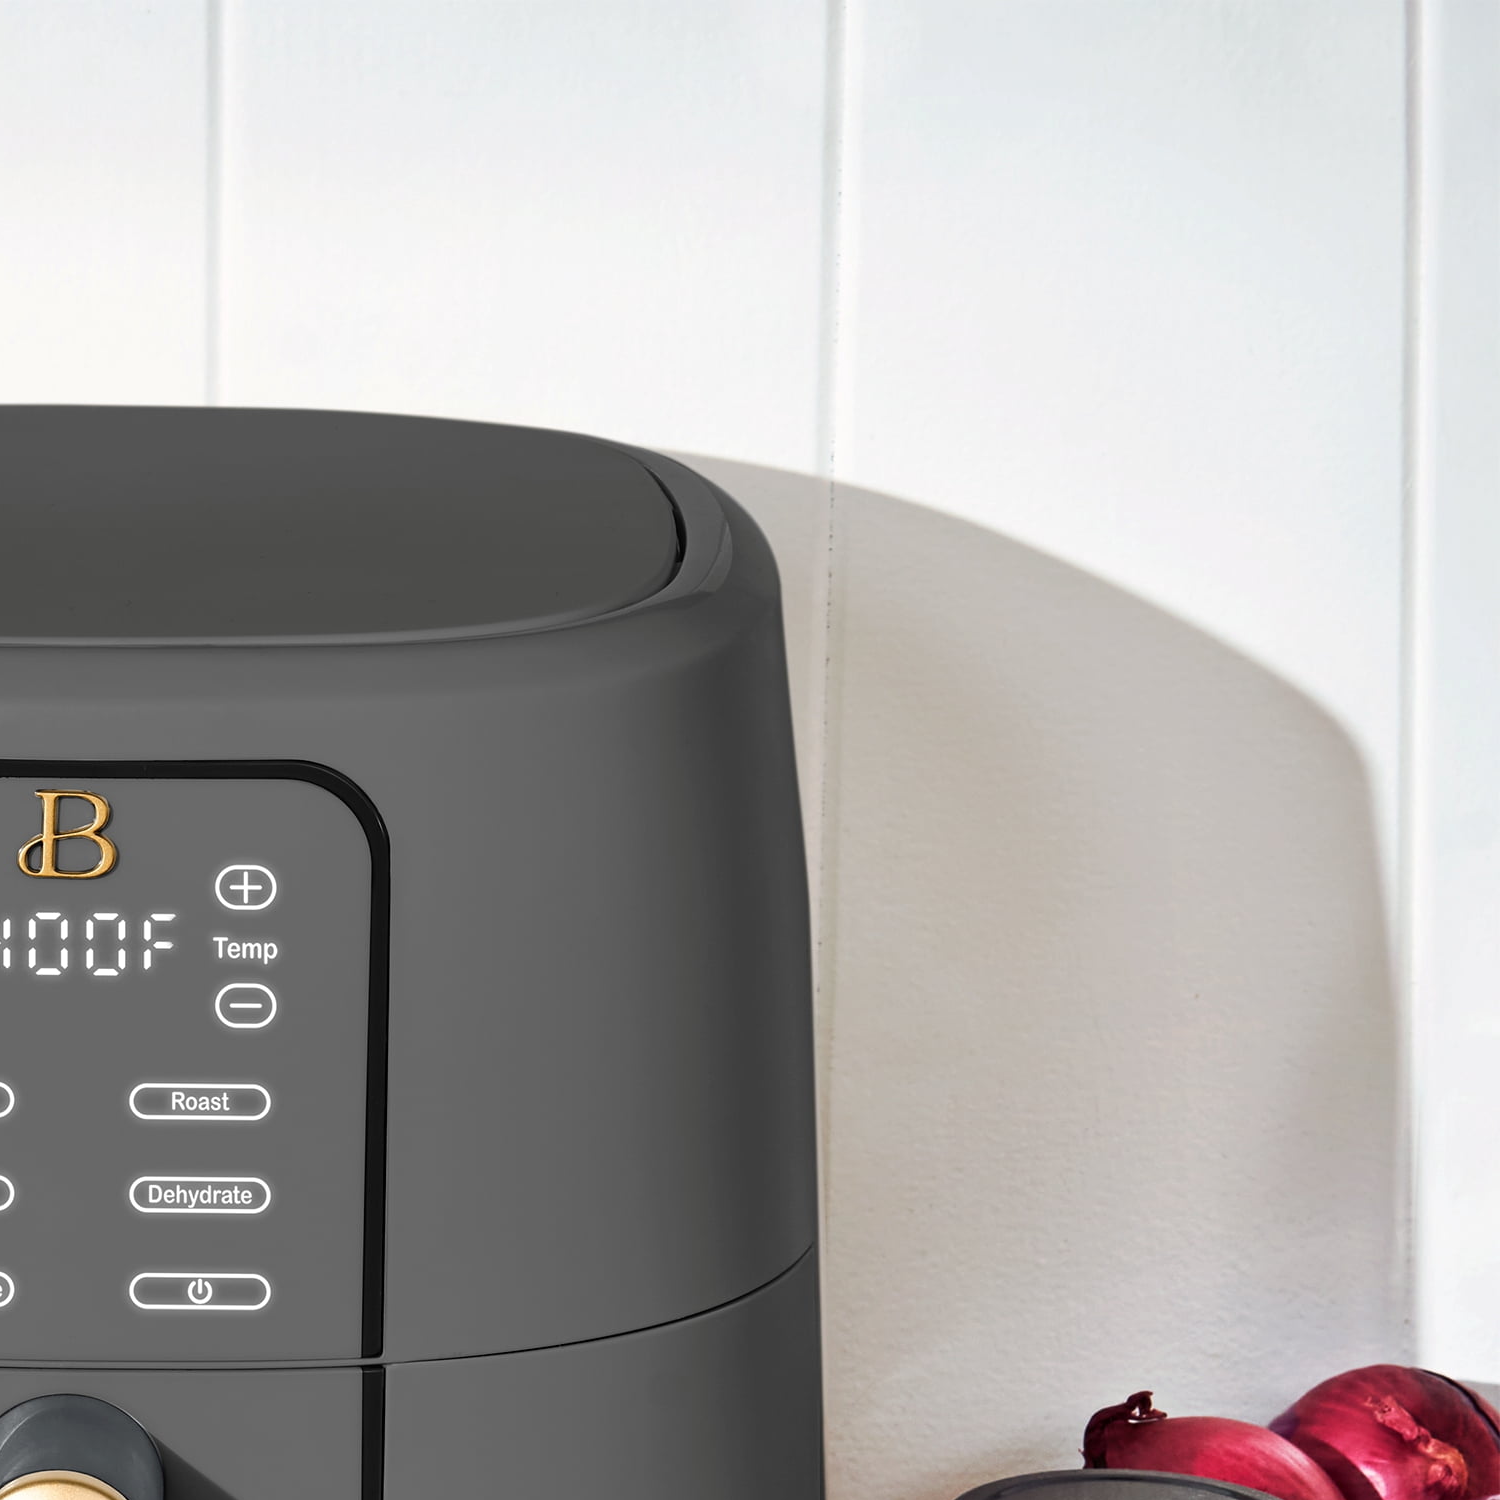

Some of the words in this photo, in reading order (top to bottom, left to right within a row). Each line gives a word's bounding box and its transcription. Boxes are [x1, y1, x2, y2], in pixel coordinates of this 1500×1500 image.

[16, 789, 119, 878] B
[213, 937, 278, 964] Temp
[171, 1090, 229, 1111] Roast
[147, 1185, 252, 1206] Dehydrate
